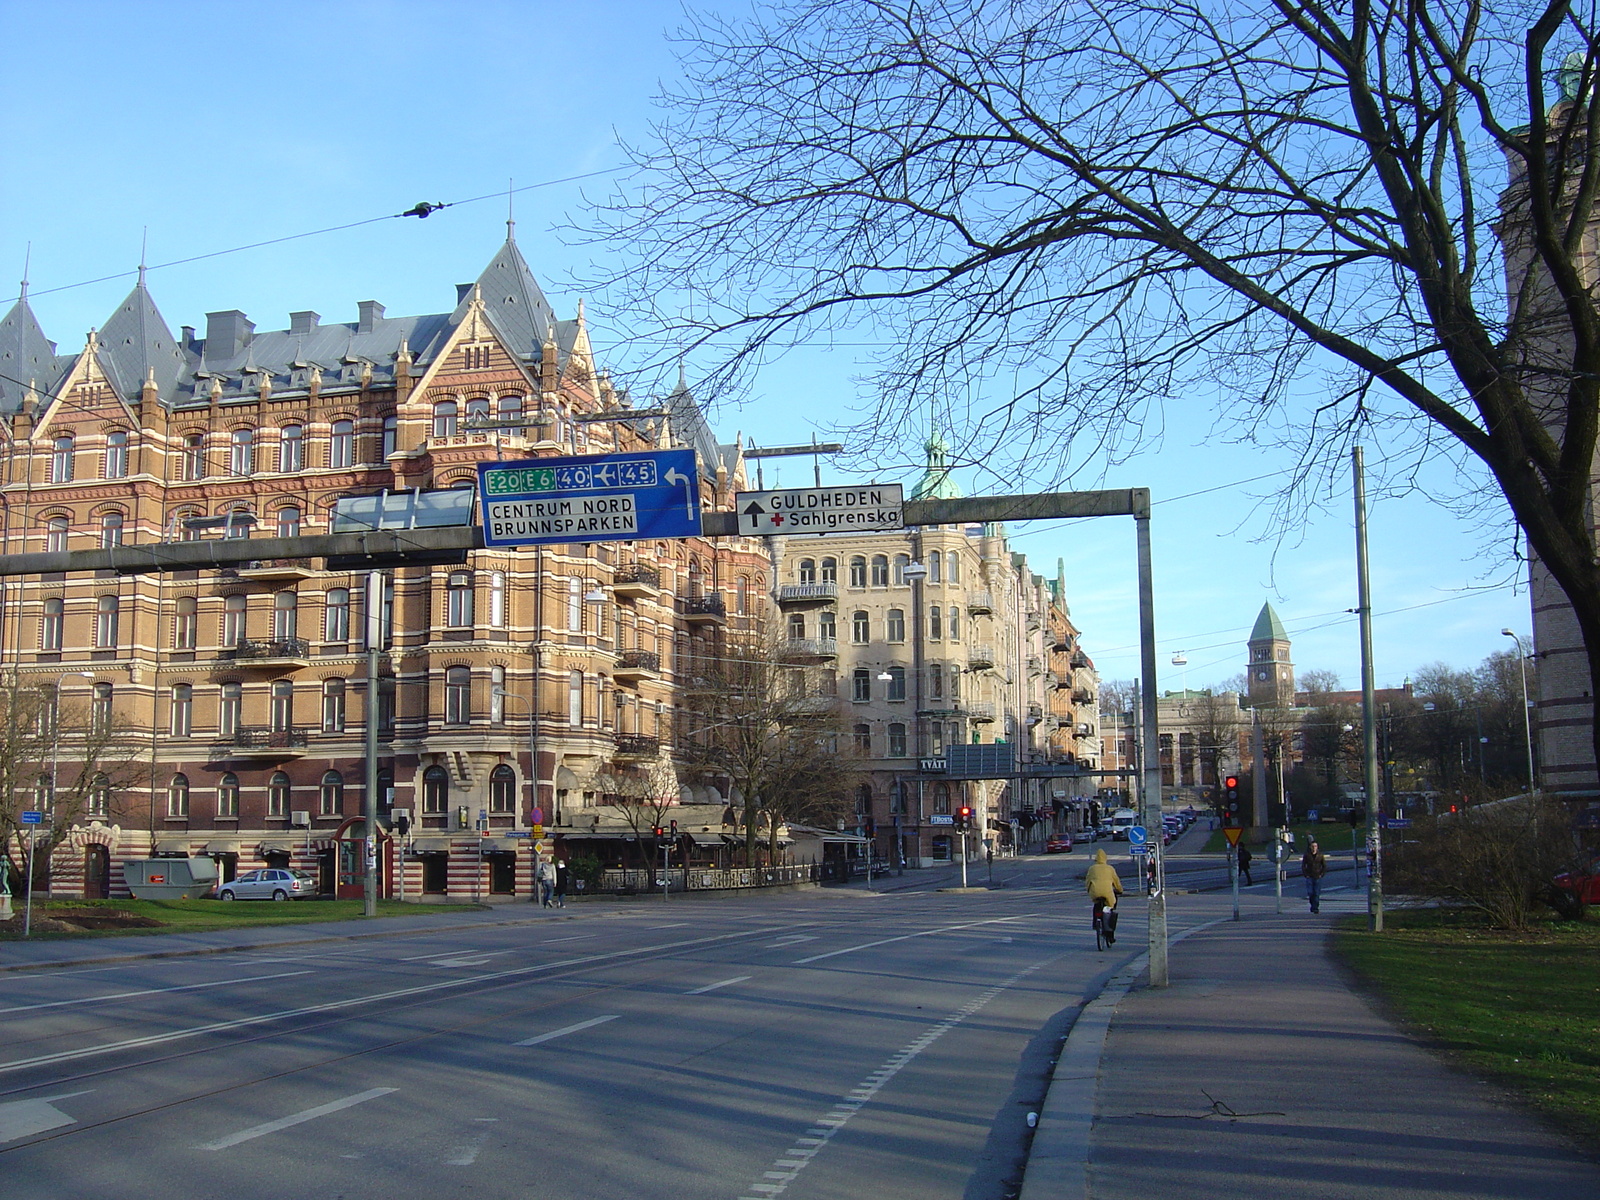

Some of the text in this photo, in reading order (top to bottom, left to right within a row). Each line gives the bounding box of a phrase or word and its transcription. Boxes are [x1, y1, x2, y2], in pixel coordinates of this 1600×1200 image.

[488, 474, 520, 490] E20
[560, 470, 586, 485] 40
[625, 466, 650, 481] 45
[492, 498, 632, 519] CENTRUM NORD
[770, 490, 882, 510] GULDHEDEN
[493, 515, 635, 536] BRUNNSPARKEN
[789, 508, 898, 528] Sahlgrenska
